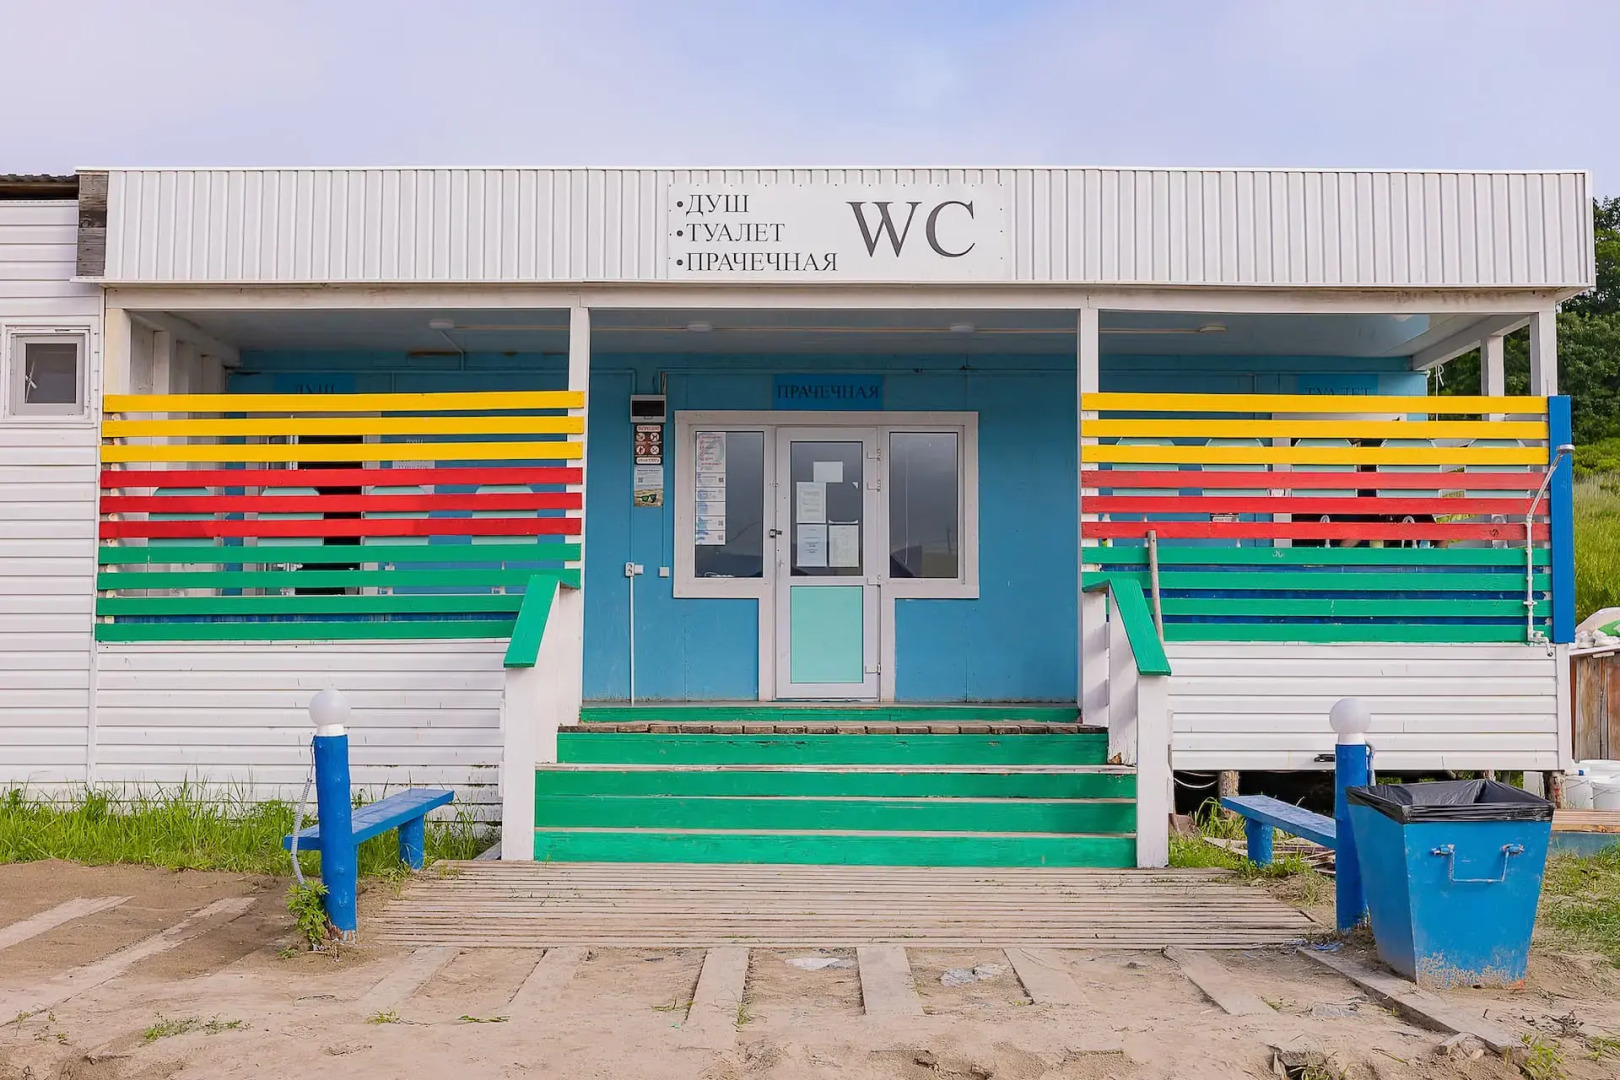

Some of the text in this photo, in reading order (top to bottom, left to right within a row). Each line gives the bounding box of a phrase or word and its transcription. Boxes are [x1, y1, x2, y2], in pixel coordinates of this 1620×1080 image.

[685, 194, 750, 217] ДУШ
[685, 223, 786, 243] ТУАЛЕТ
[845, 200, 976, 258] WC
[685, 252, 838, 272] ПРАЧЕЧНАЯ
[777, 384, 879, 399] ПРАЧЕЧНАЯ
